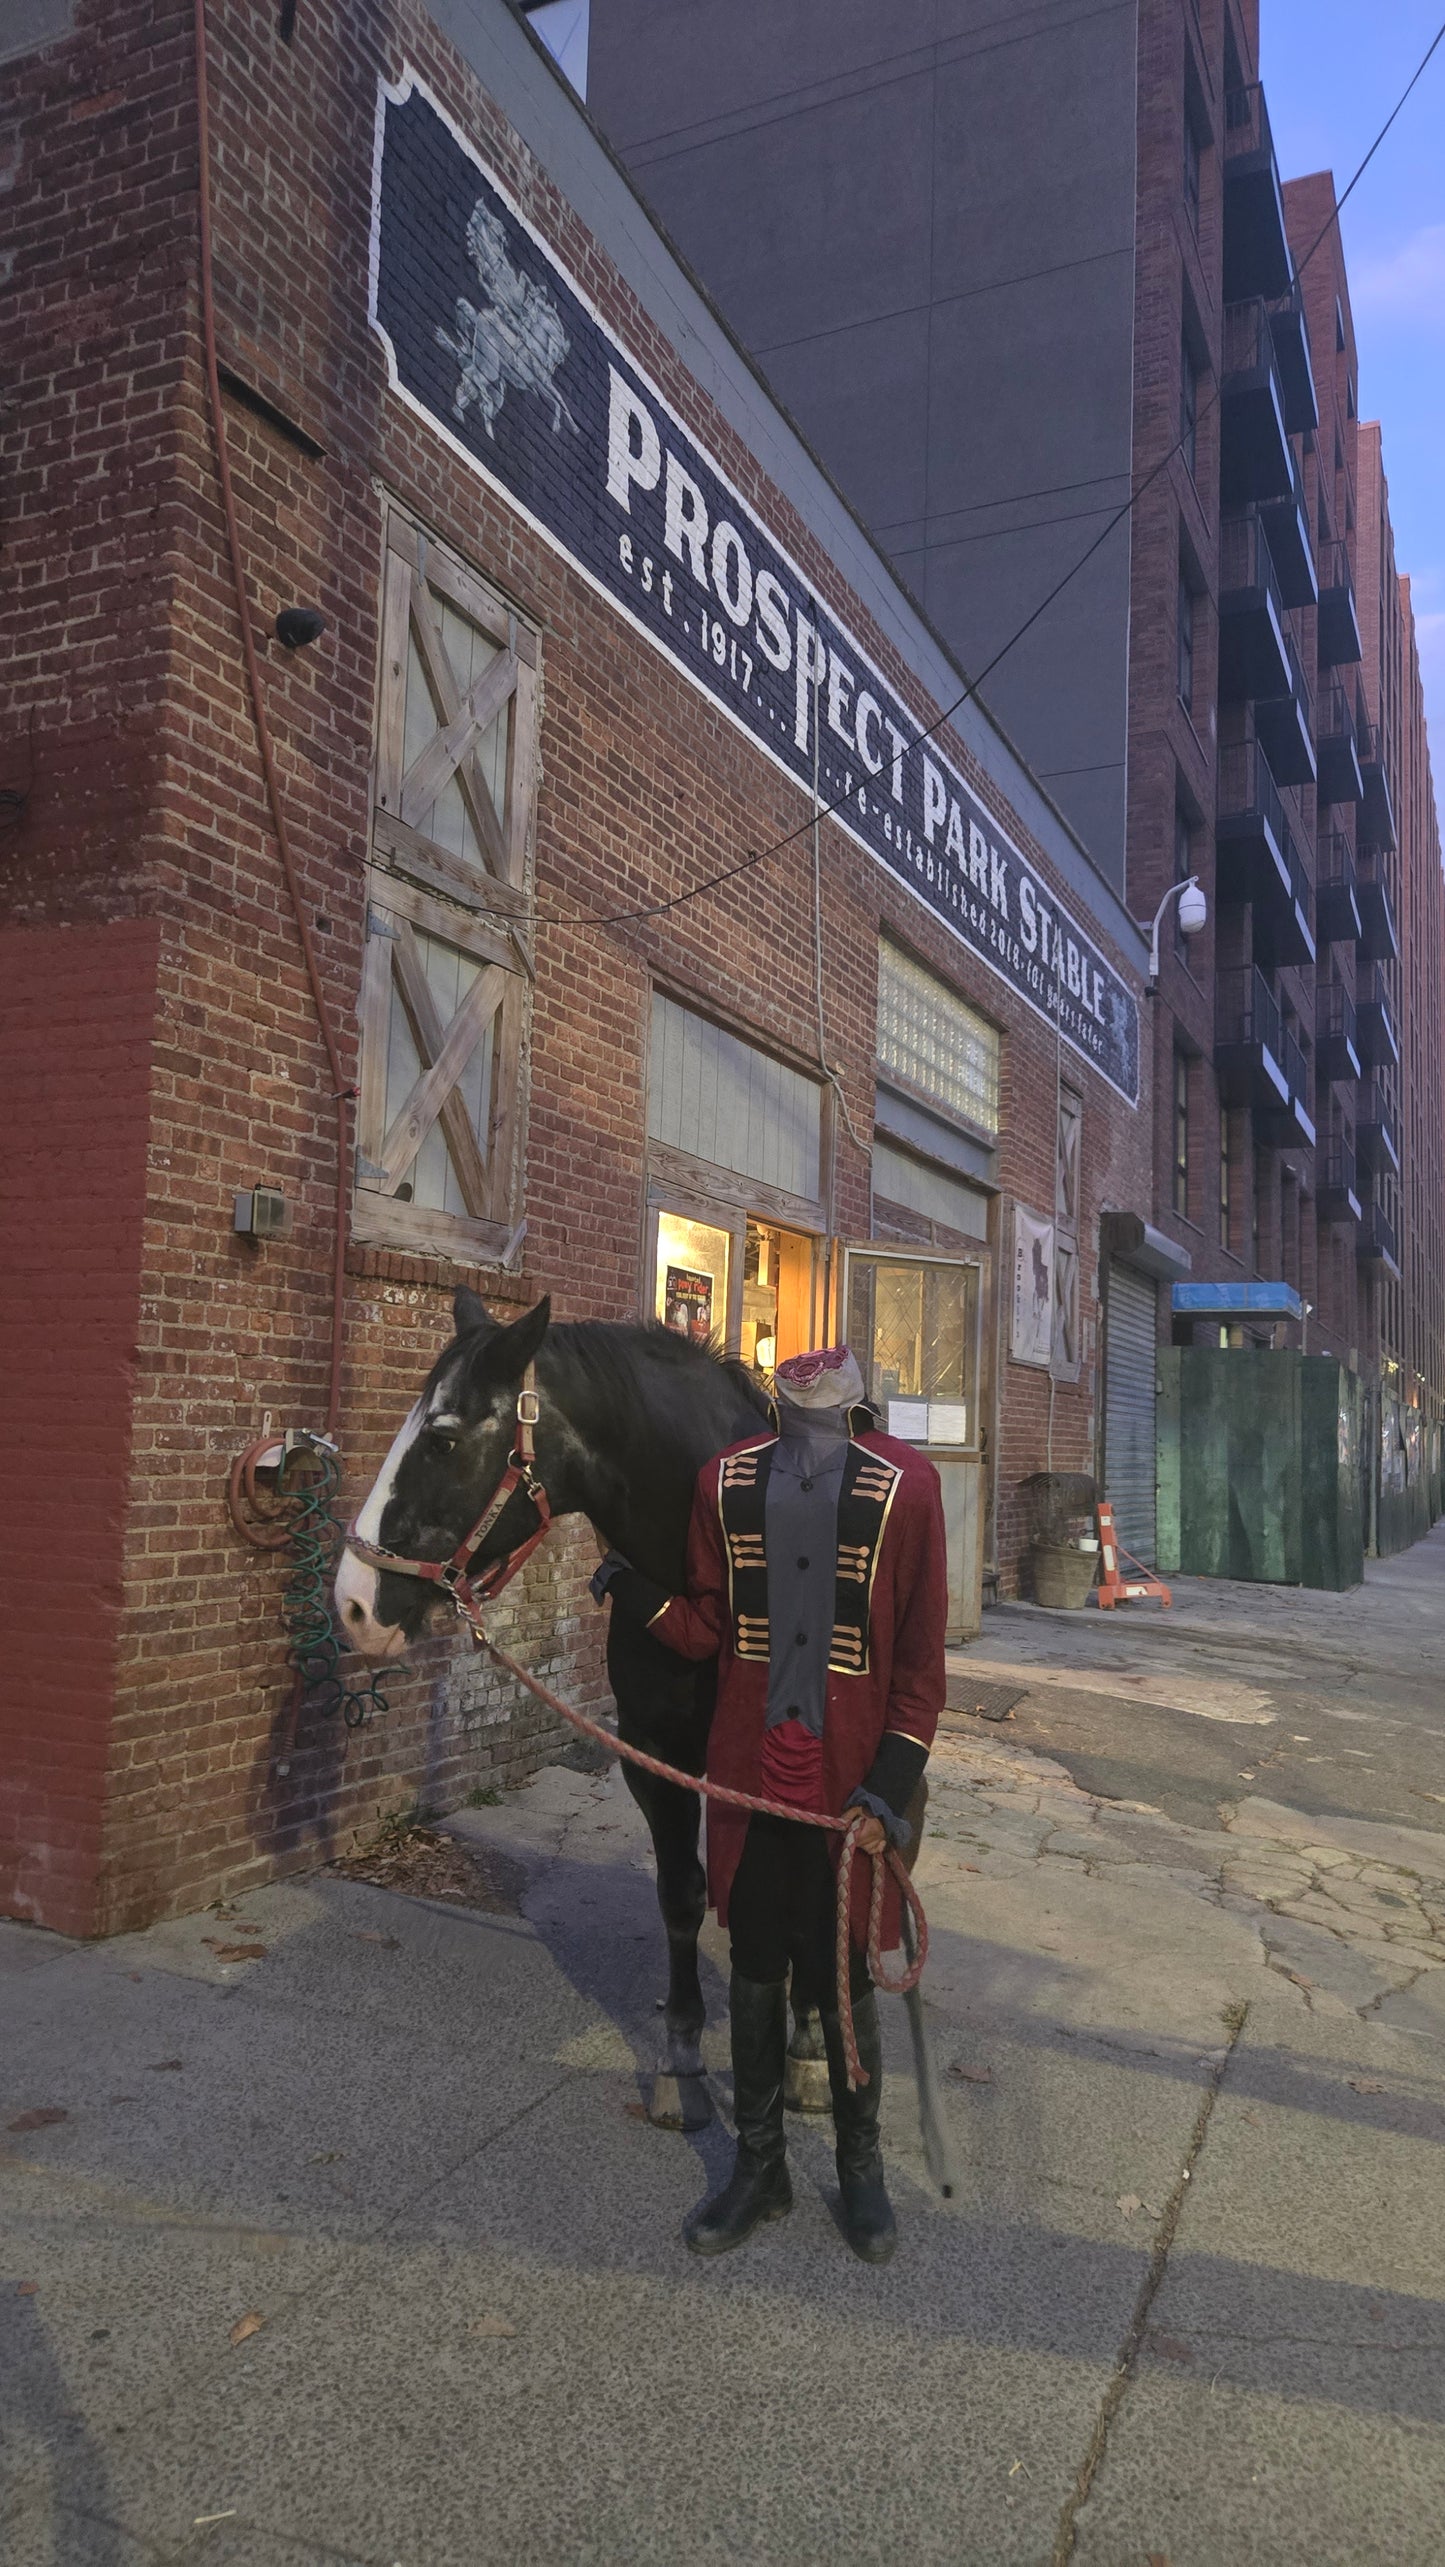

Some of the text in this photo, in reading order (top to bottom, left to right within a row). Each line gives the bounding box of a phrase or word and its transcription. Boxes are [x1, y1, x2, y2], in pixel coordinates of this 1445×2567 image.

[605, 361, 1106, 1027] PROSPECT PARK STABLE
[474, 1503, 503, 1538] TONKA
